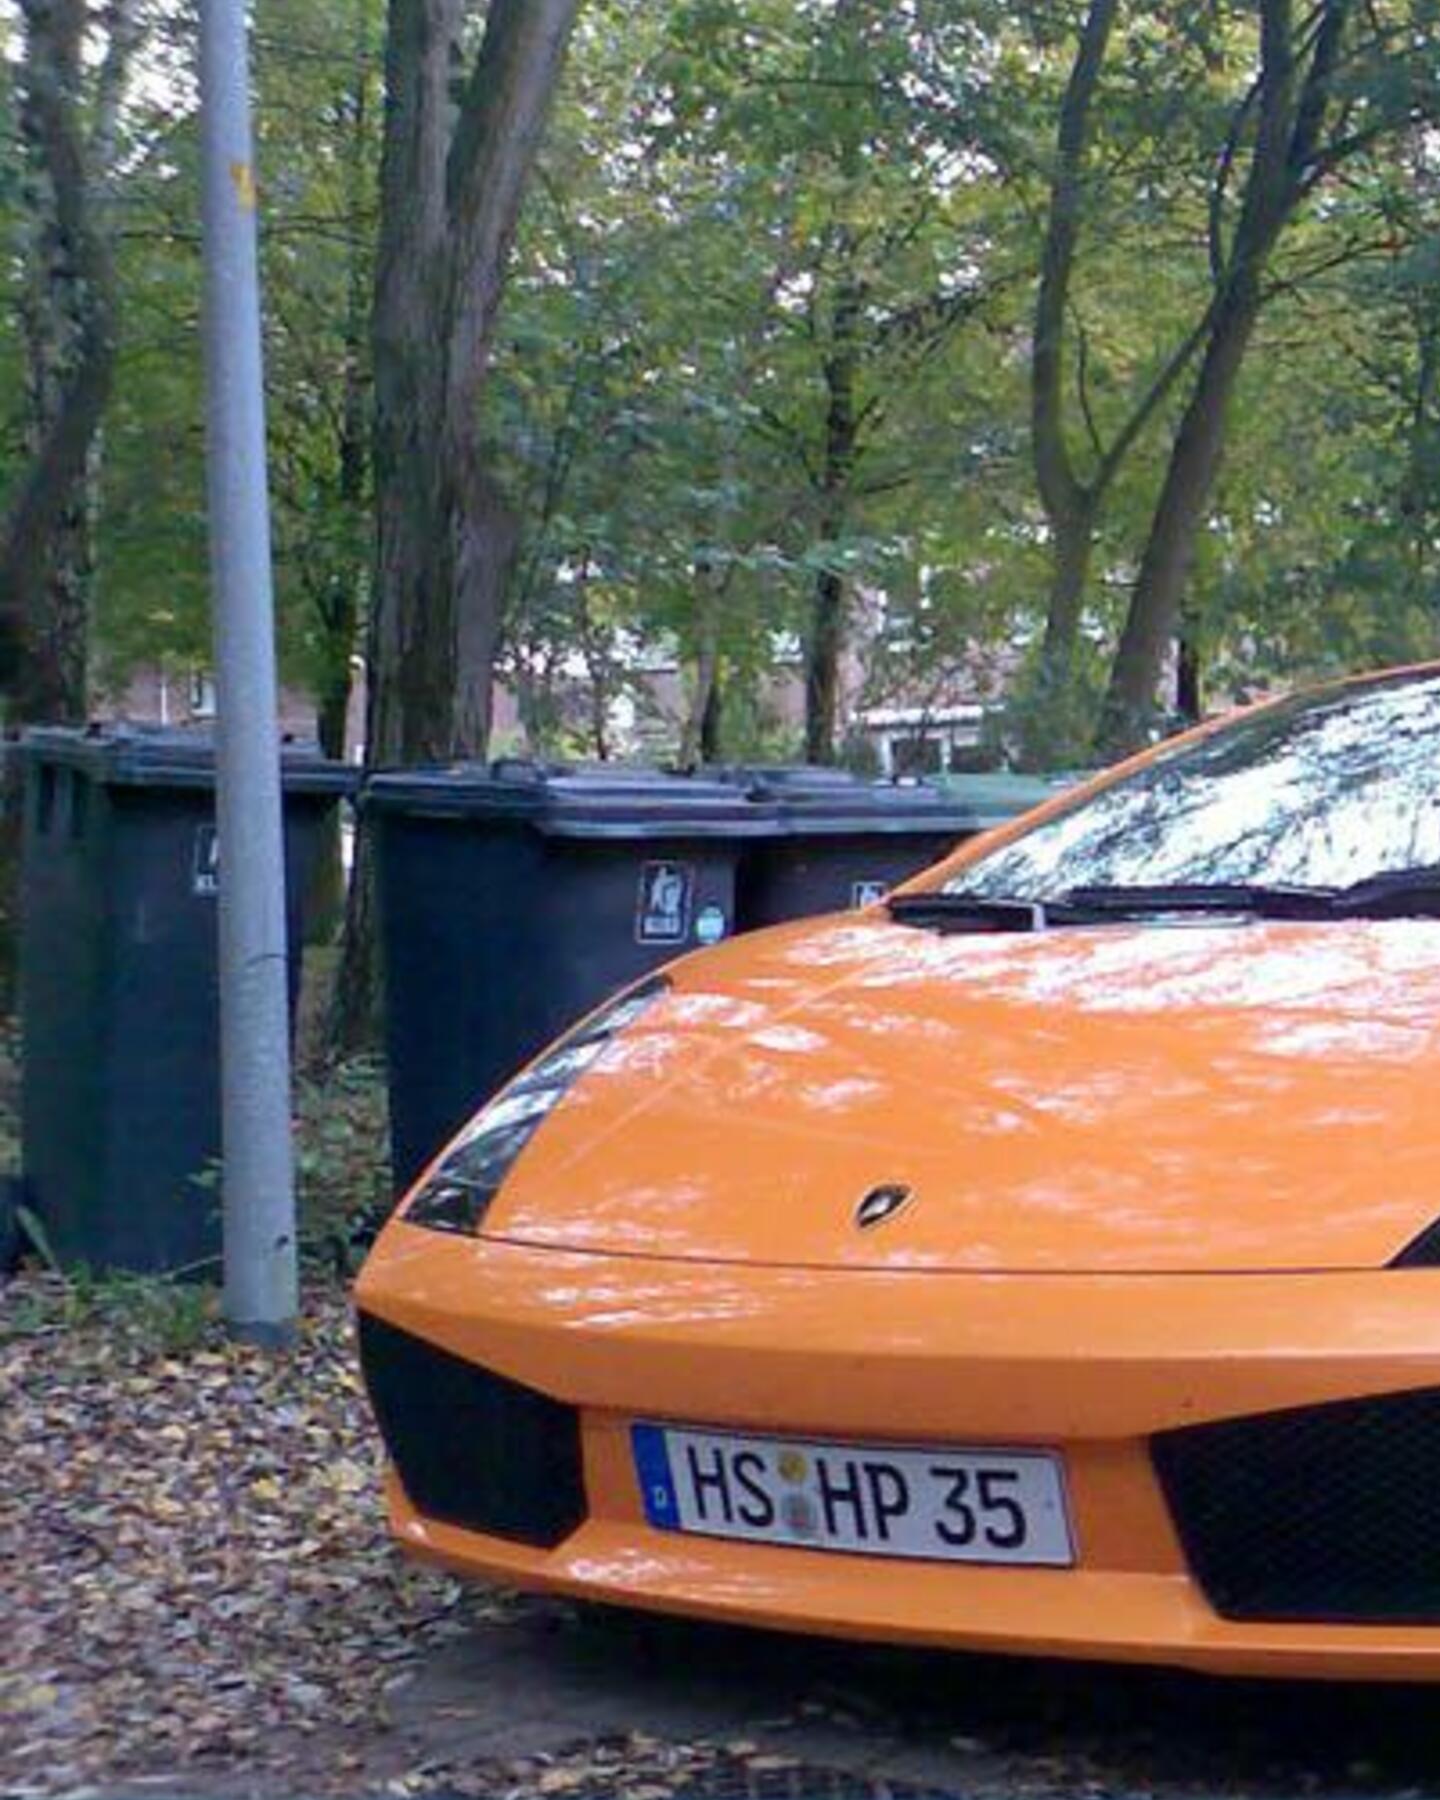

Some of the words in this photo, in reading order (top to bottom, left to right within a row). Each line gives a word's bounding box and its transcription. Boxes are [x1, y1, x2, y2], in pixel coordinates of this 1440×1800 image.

[686, 1446, 775, 1527] HS
[816, 1459, 909, 1539] HP
[930, 1468, 1026, 1548] 35
